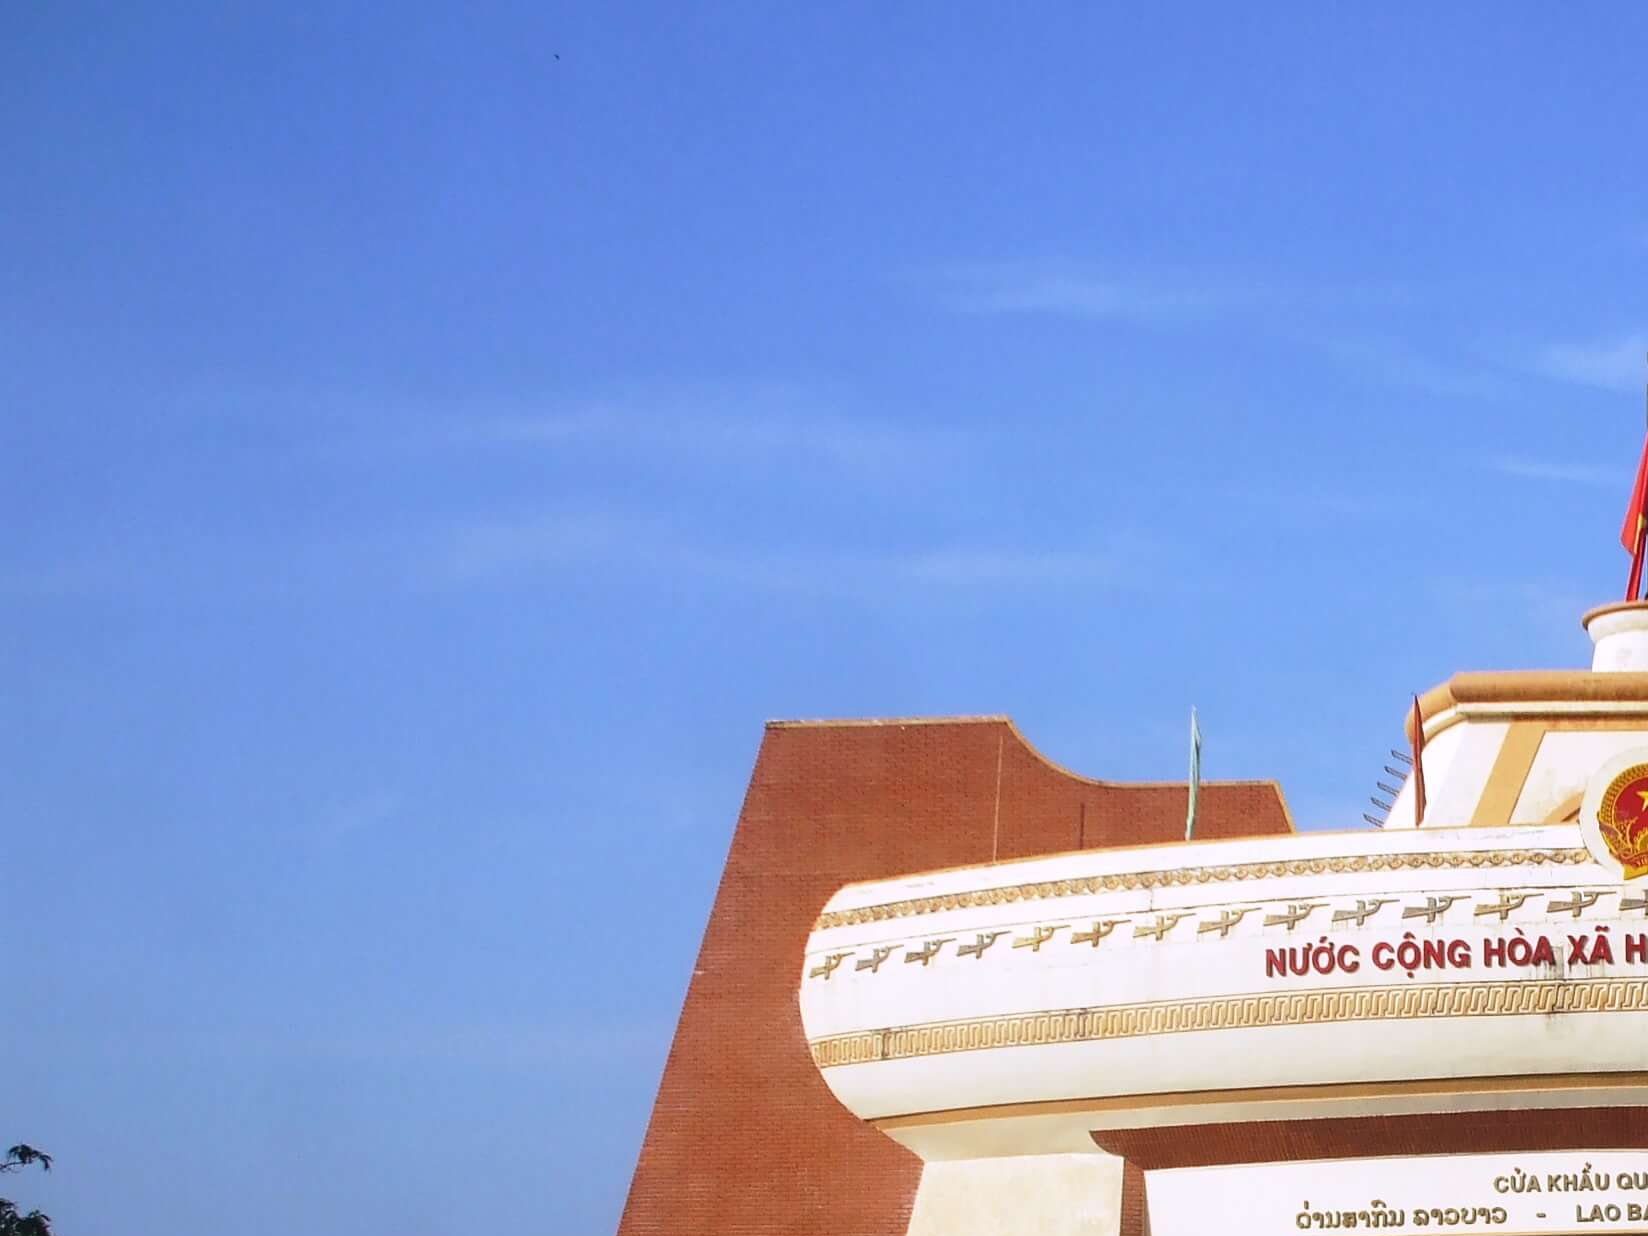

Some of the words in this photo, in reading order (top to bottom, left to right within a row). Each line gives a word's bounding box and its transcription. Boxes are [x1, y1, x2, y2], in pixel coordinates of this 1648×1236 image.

[1265, 935, 1360, 978] NƯỚC
[1371, 932, 1472, 978] CỘNG
[1484, 927, 1556, 968] HÒA
[1567, 925, 1614, 966] XÃ
[1493, 1166, 1541, 1194] CỬA
[1548, 1161, 1610, 1193] KHẨU
[1576, 1203, 1621, 1222] LAO
